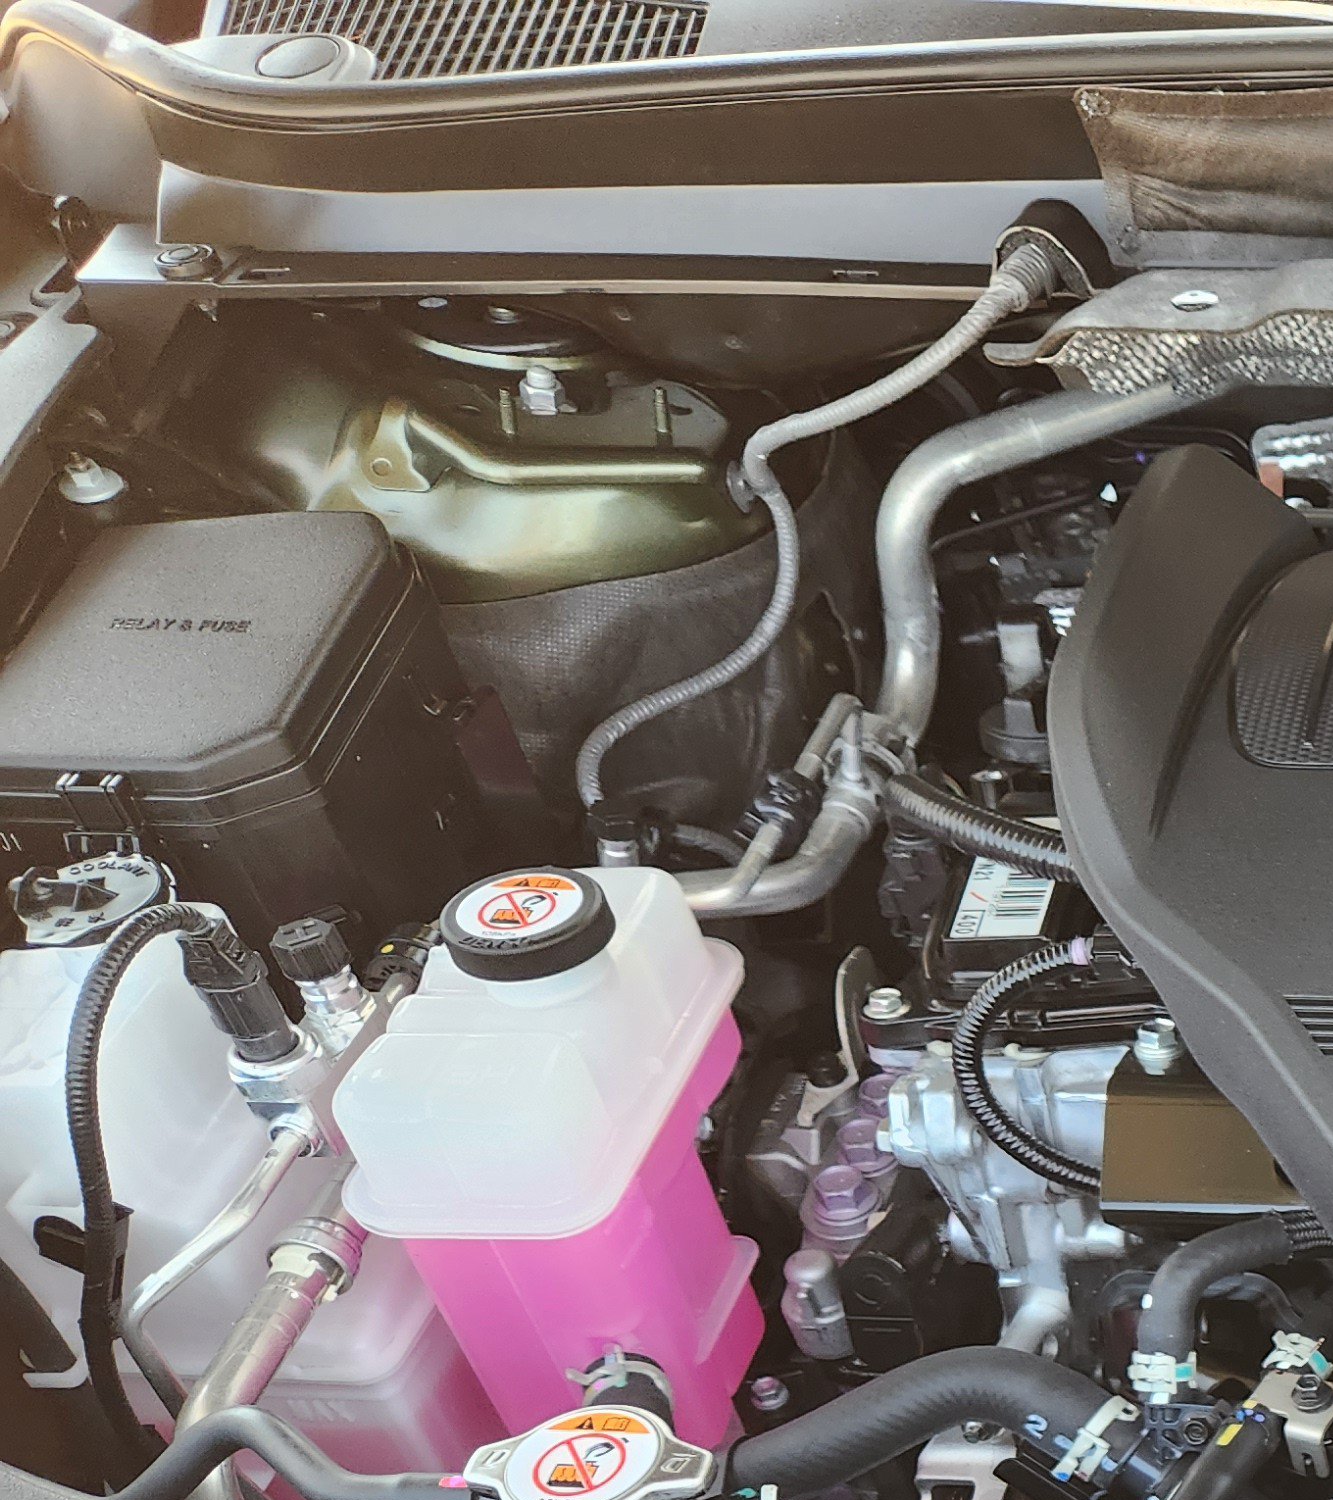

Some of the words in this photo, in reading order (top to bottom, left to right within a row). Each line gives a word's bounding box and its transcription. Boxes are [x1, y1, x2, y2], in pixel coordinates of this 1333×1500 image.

[109, 617, 176, 631] RELAY
[199, 618, 251, 633] FUSE
[69, 861, 150, 877] COOLANT
[1024, 1414, 1049, 1440] 2
